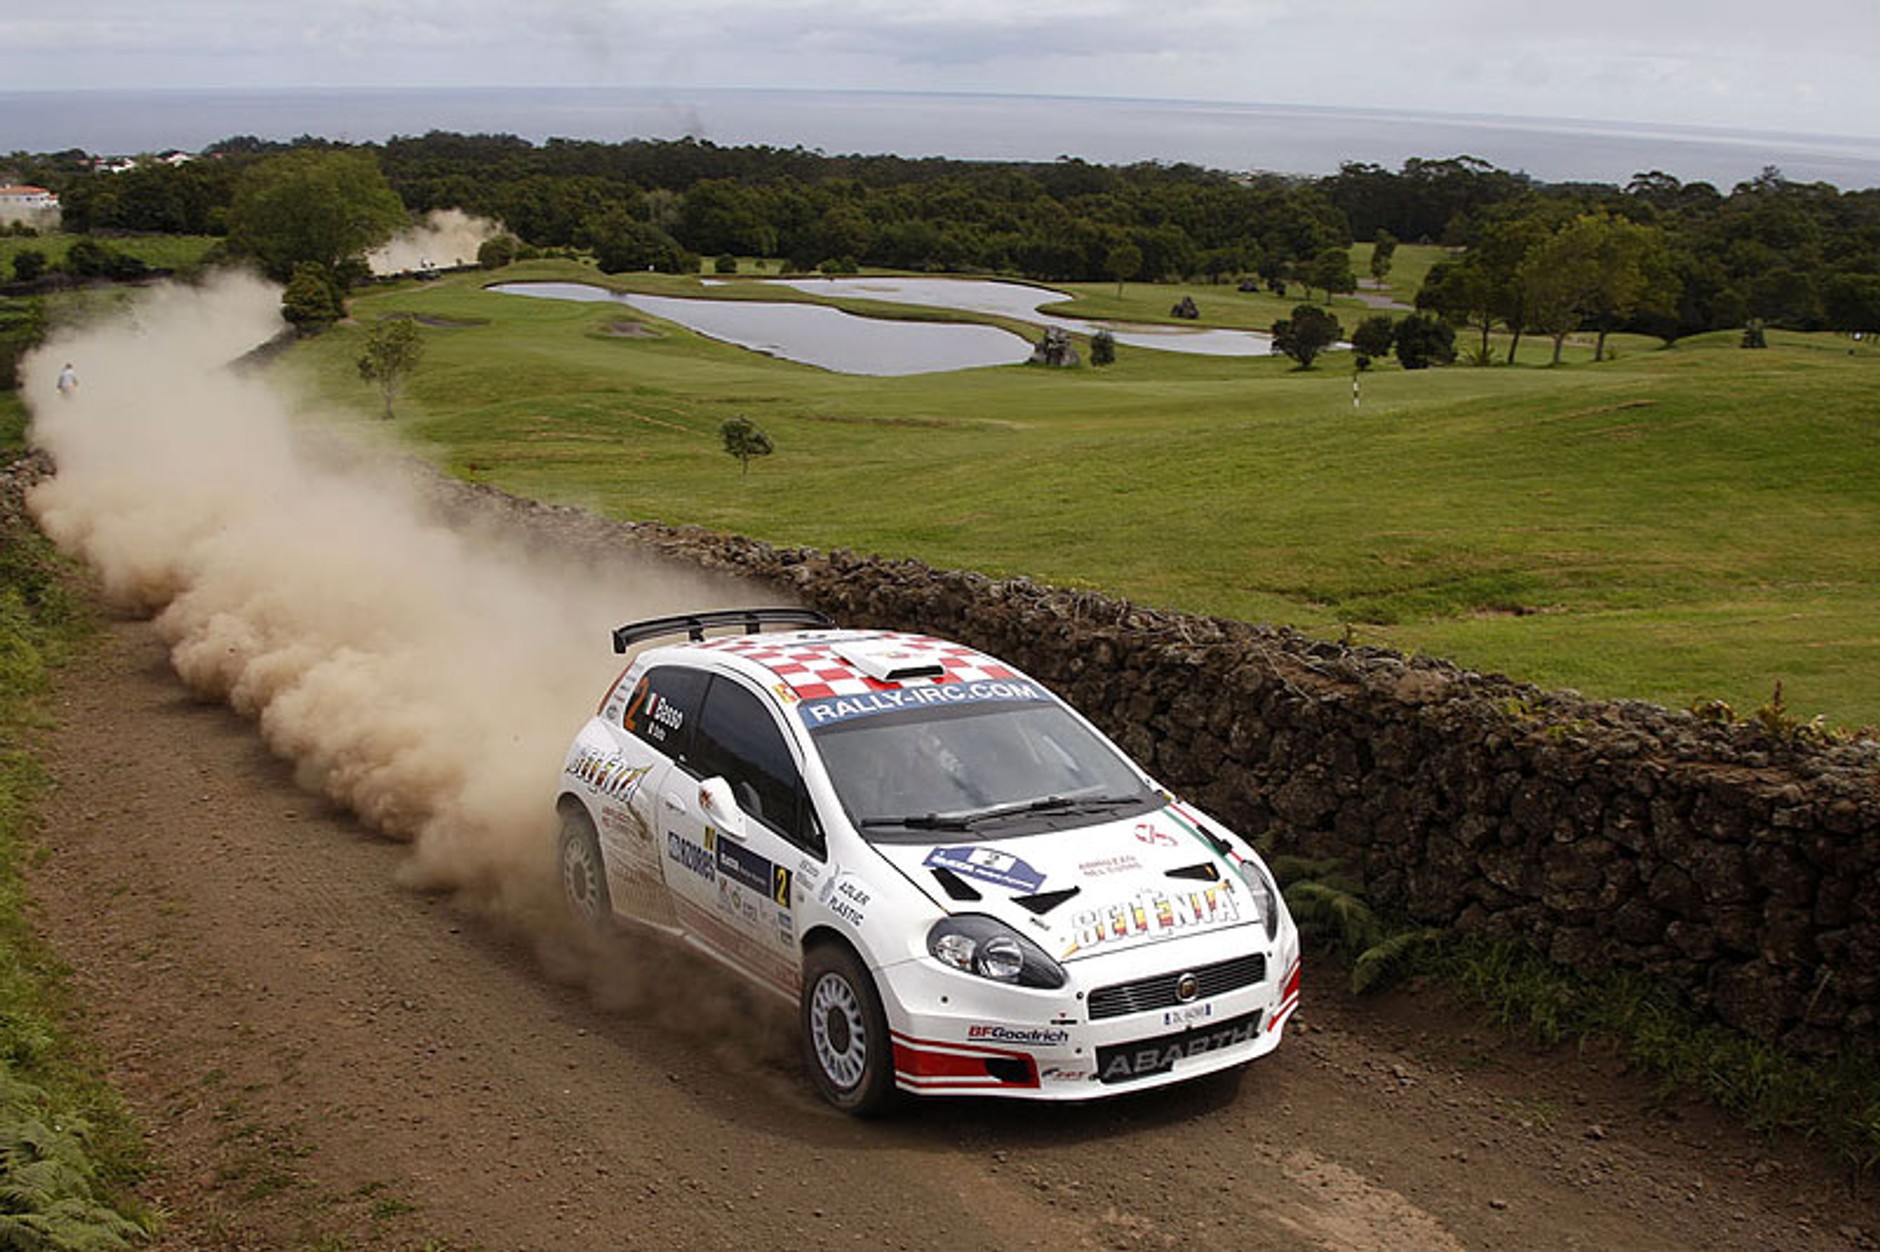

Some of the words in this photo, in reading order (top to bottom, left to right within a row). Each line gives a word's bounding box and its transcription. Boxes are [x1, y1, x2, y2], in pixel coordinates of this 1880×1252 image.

[624, 676, 649, 732] 2
[809, 684, 1039, 722] RALLY-IRC.COM
[777, 868, 788, 908] 2
[968, 1025, 1069, 1044] BFGoodrich
[1103, 1022, 1256, 1078] ABARTH
